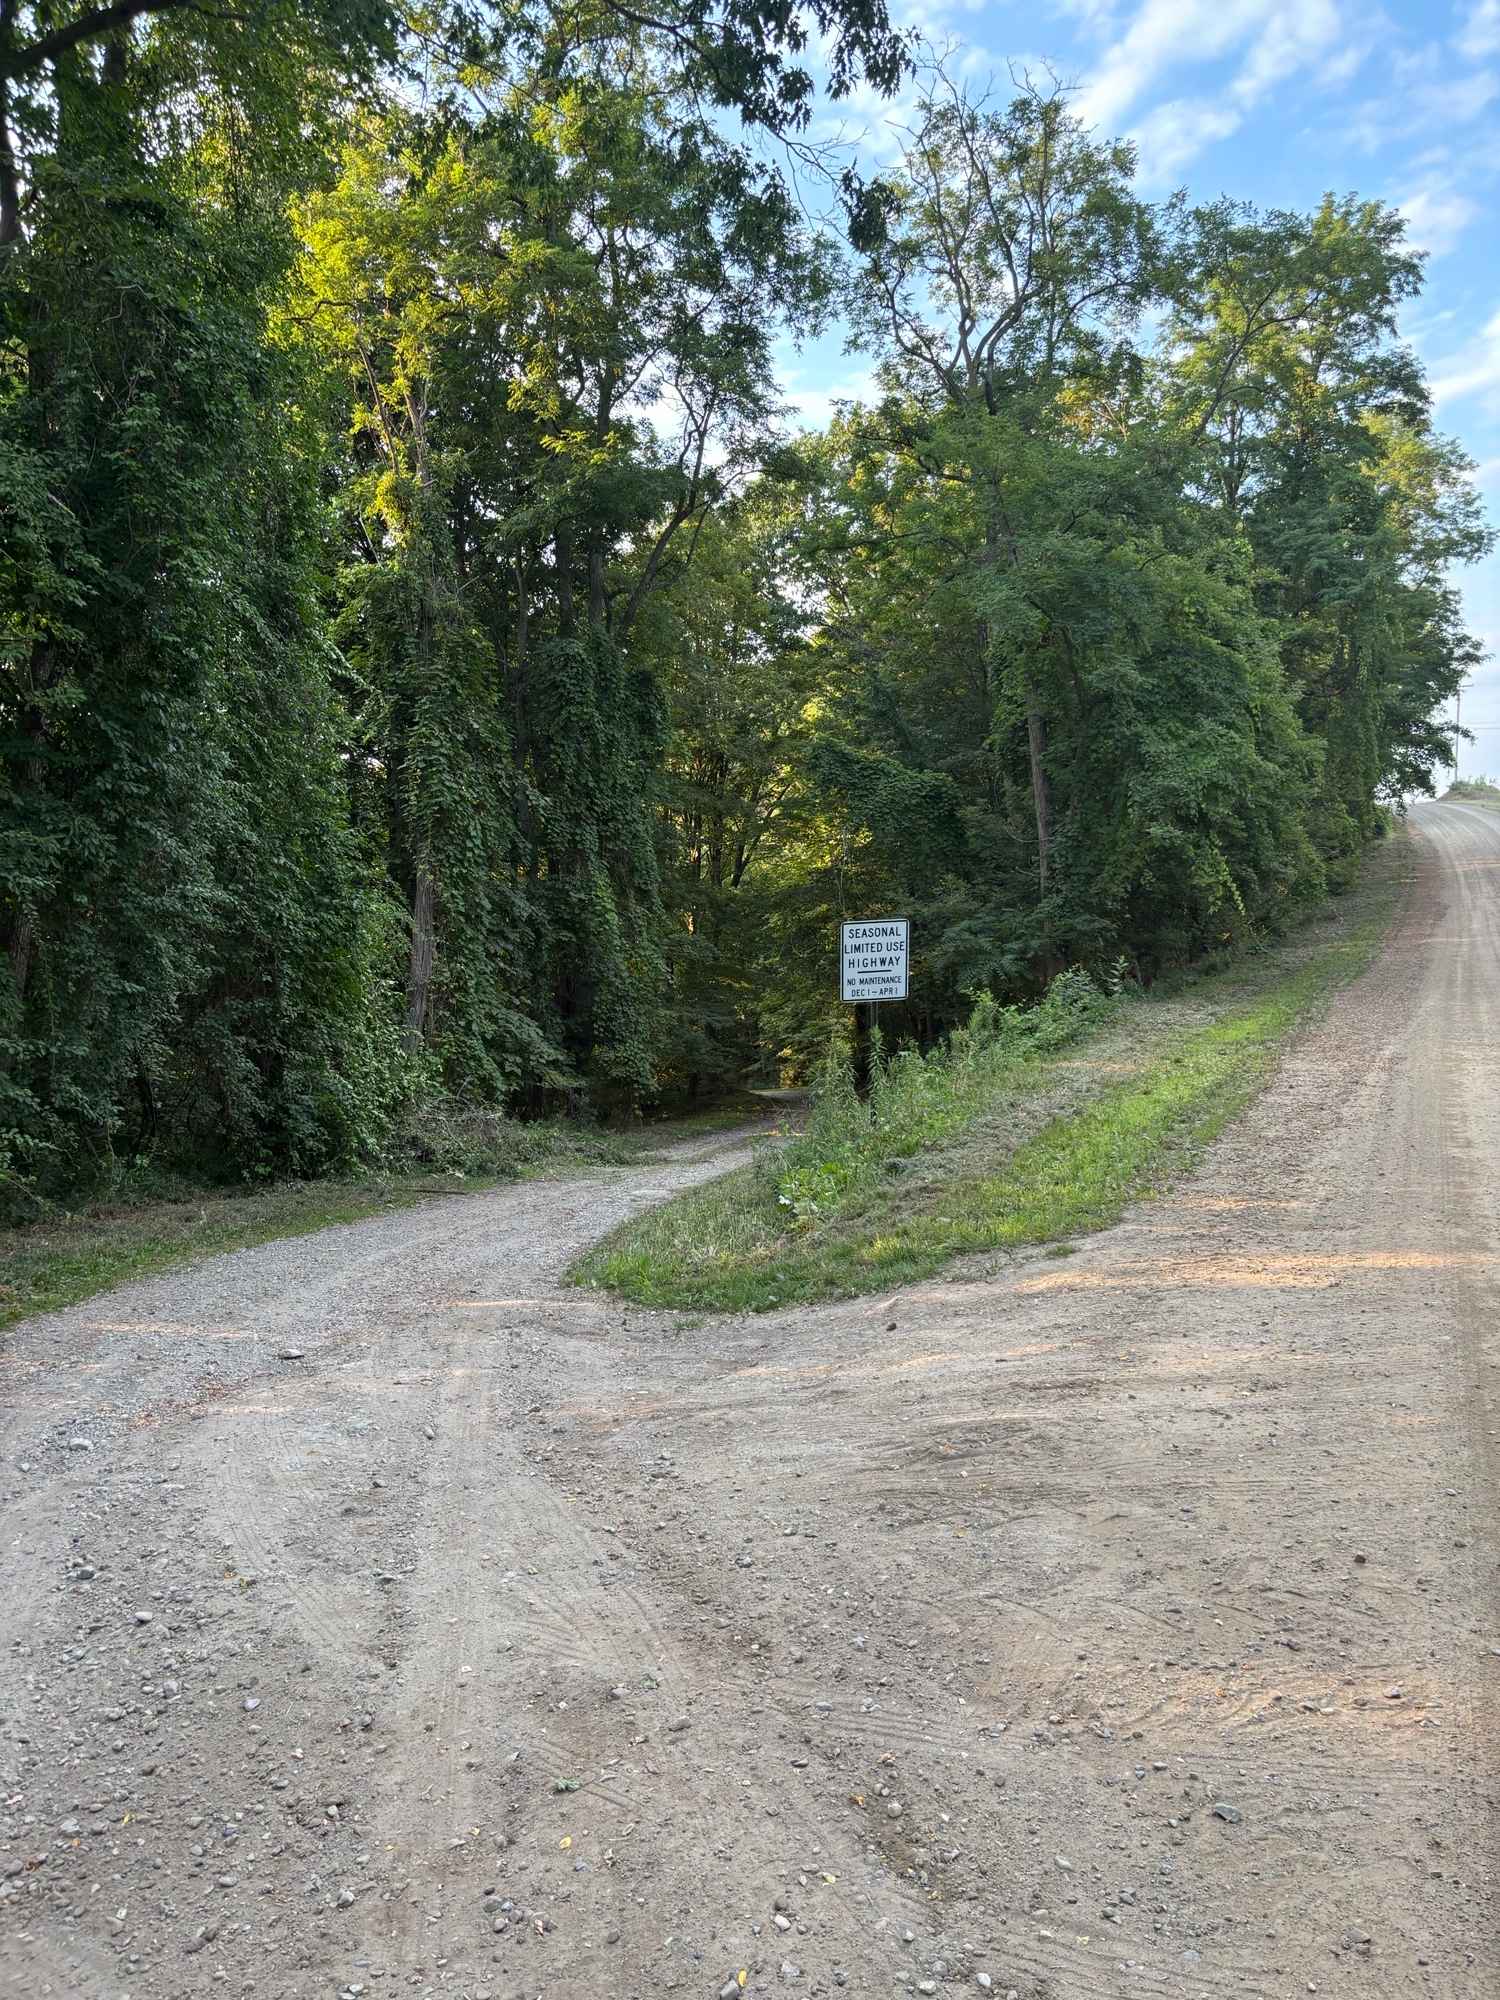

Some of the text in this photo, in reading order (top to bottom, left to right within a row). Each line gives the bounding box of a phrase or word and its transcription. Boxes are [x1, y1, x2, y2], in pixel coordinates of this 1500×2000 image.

[848, 926, 901, 939] SEASONAL
[844, 941, 905, 954] LIMITED USE
[848, 956, 901, 968] HIGHWAY
[847, 976, 902, 986] NO MAINTENANCE
[851, 988, 865, 997] DEC
[878, 987, 893, 996] APR
